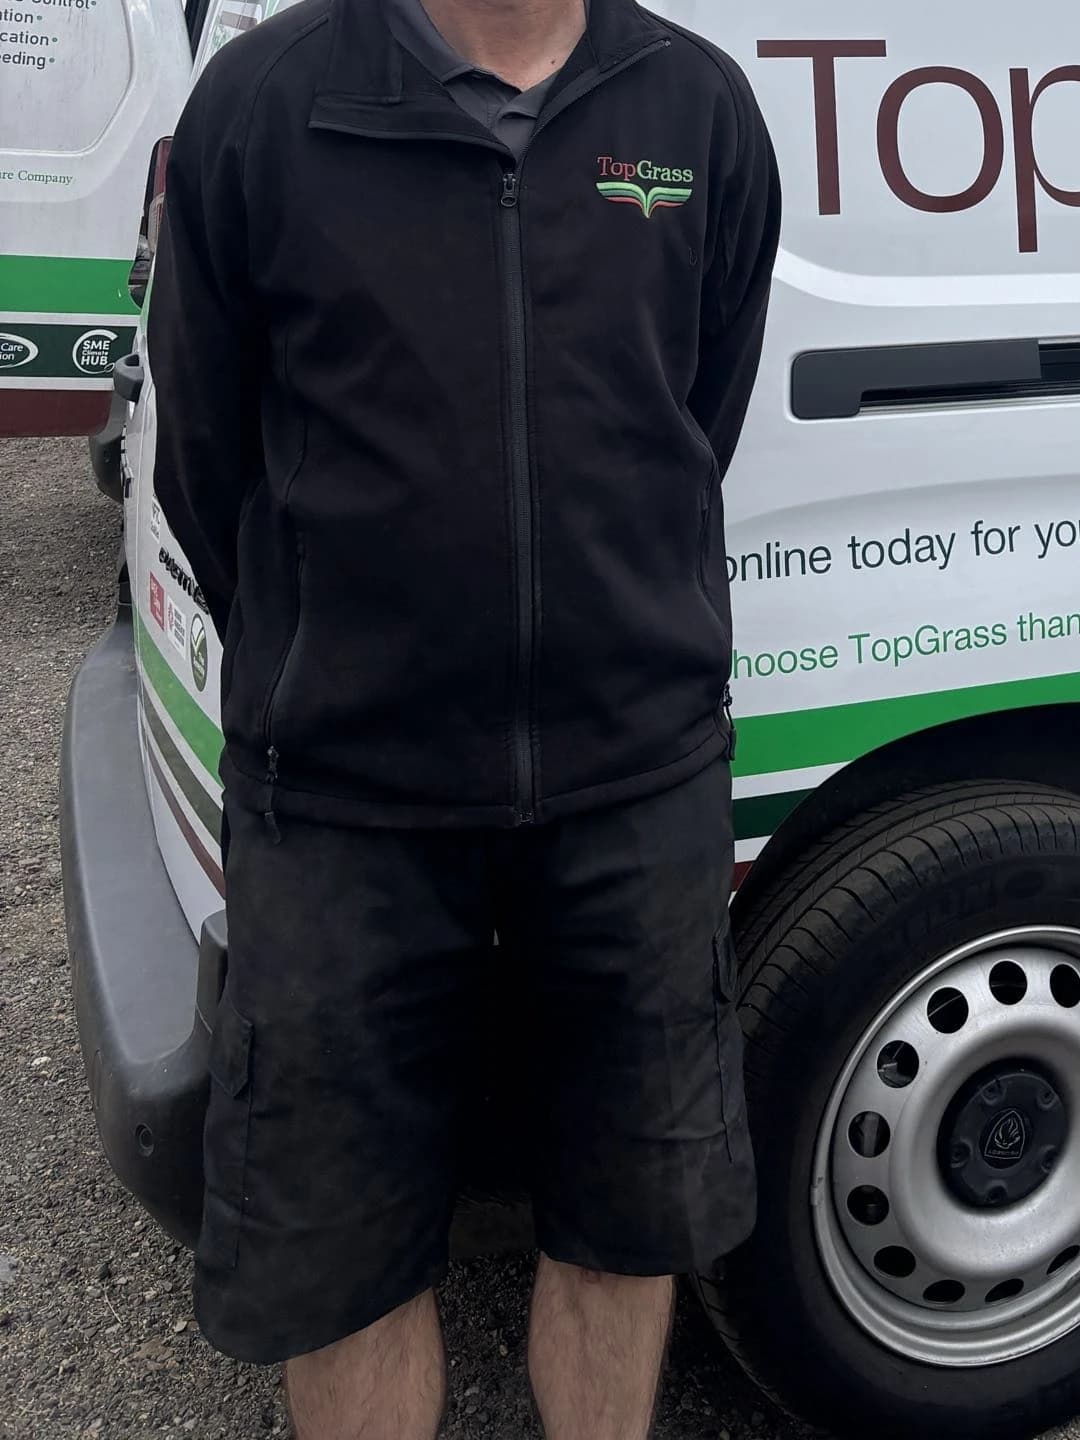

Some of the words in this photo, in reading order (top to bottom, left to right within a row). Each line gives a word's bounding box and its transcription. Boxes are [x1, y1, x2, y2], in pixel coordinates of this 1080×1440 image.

[0, 31, 49, 46] cation
[0, 51, 46, 70] eding
[597, 156, 694, 182] TopGrass
[18, 170, 74, 185] Company
[0, 342, 24, 352] Care
[83, 340, 110, 350] SME
[81, 356, 108, 366] HUB
[848, 528, 956, 570] today
[970, 520, 1021, 556] for
[848, 623, 1007, 667] TopGrass
